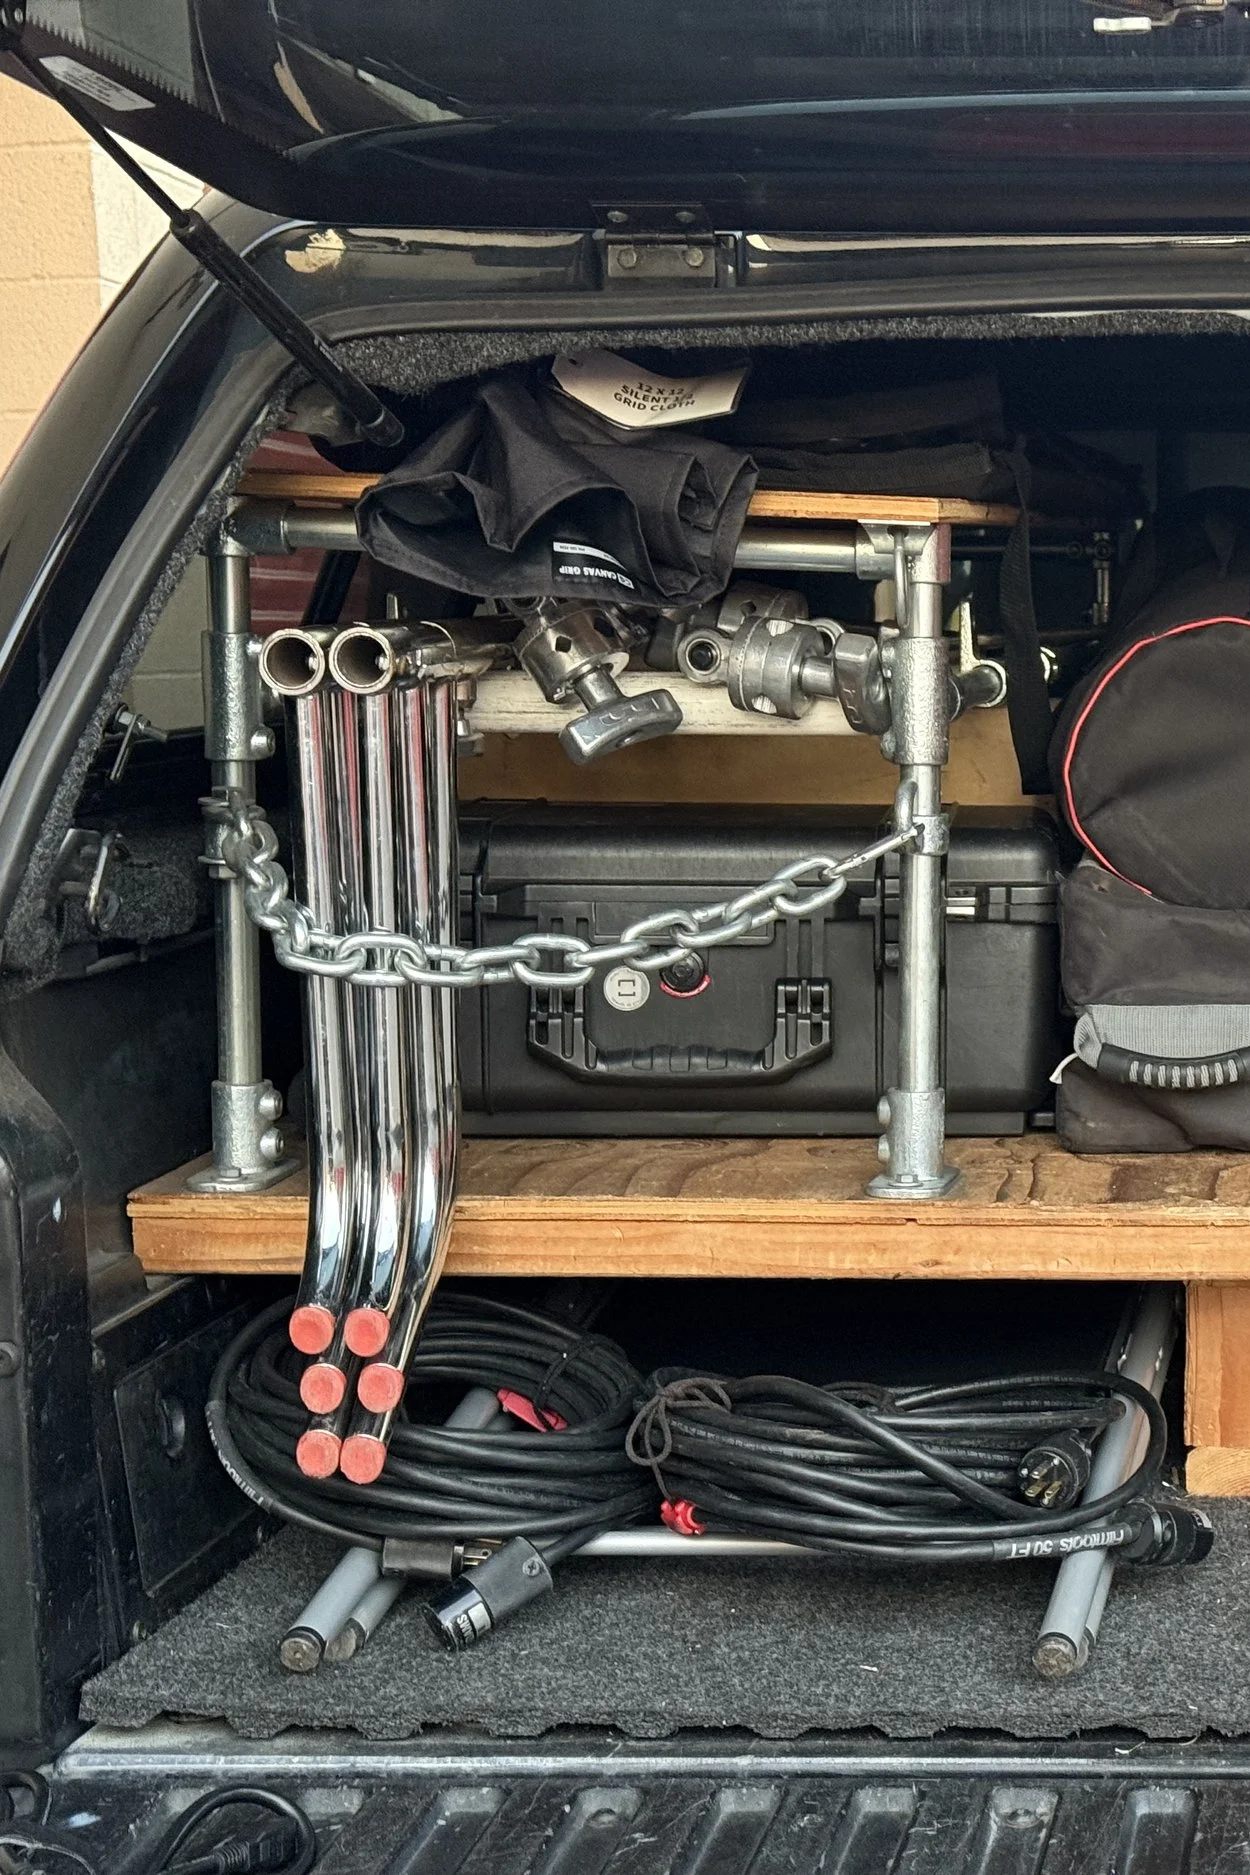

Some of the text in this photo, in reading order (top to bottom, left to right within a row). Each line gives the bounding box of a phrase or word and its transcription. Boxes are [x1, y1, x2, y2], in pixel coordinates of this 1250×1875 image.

[620, 384, 670, 404] SILENT
[637, 381, 653, 394] 12
[668, 387, 685, 396] 12
[613, 391, 696, 412] GRID CLOTH
[558, 565, 617, 580] CANVAS GRIP
[1005, 1542, 1031, 1559] FT
[1033, 1540, 1054, 1556] 50
